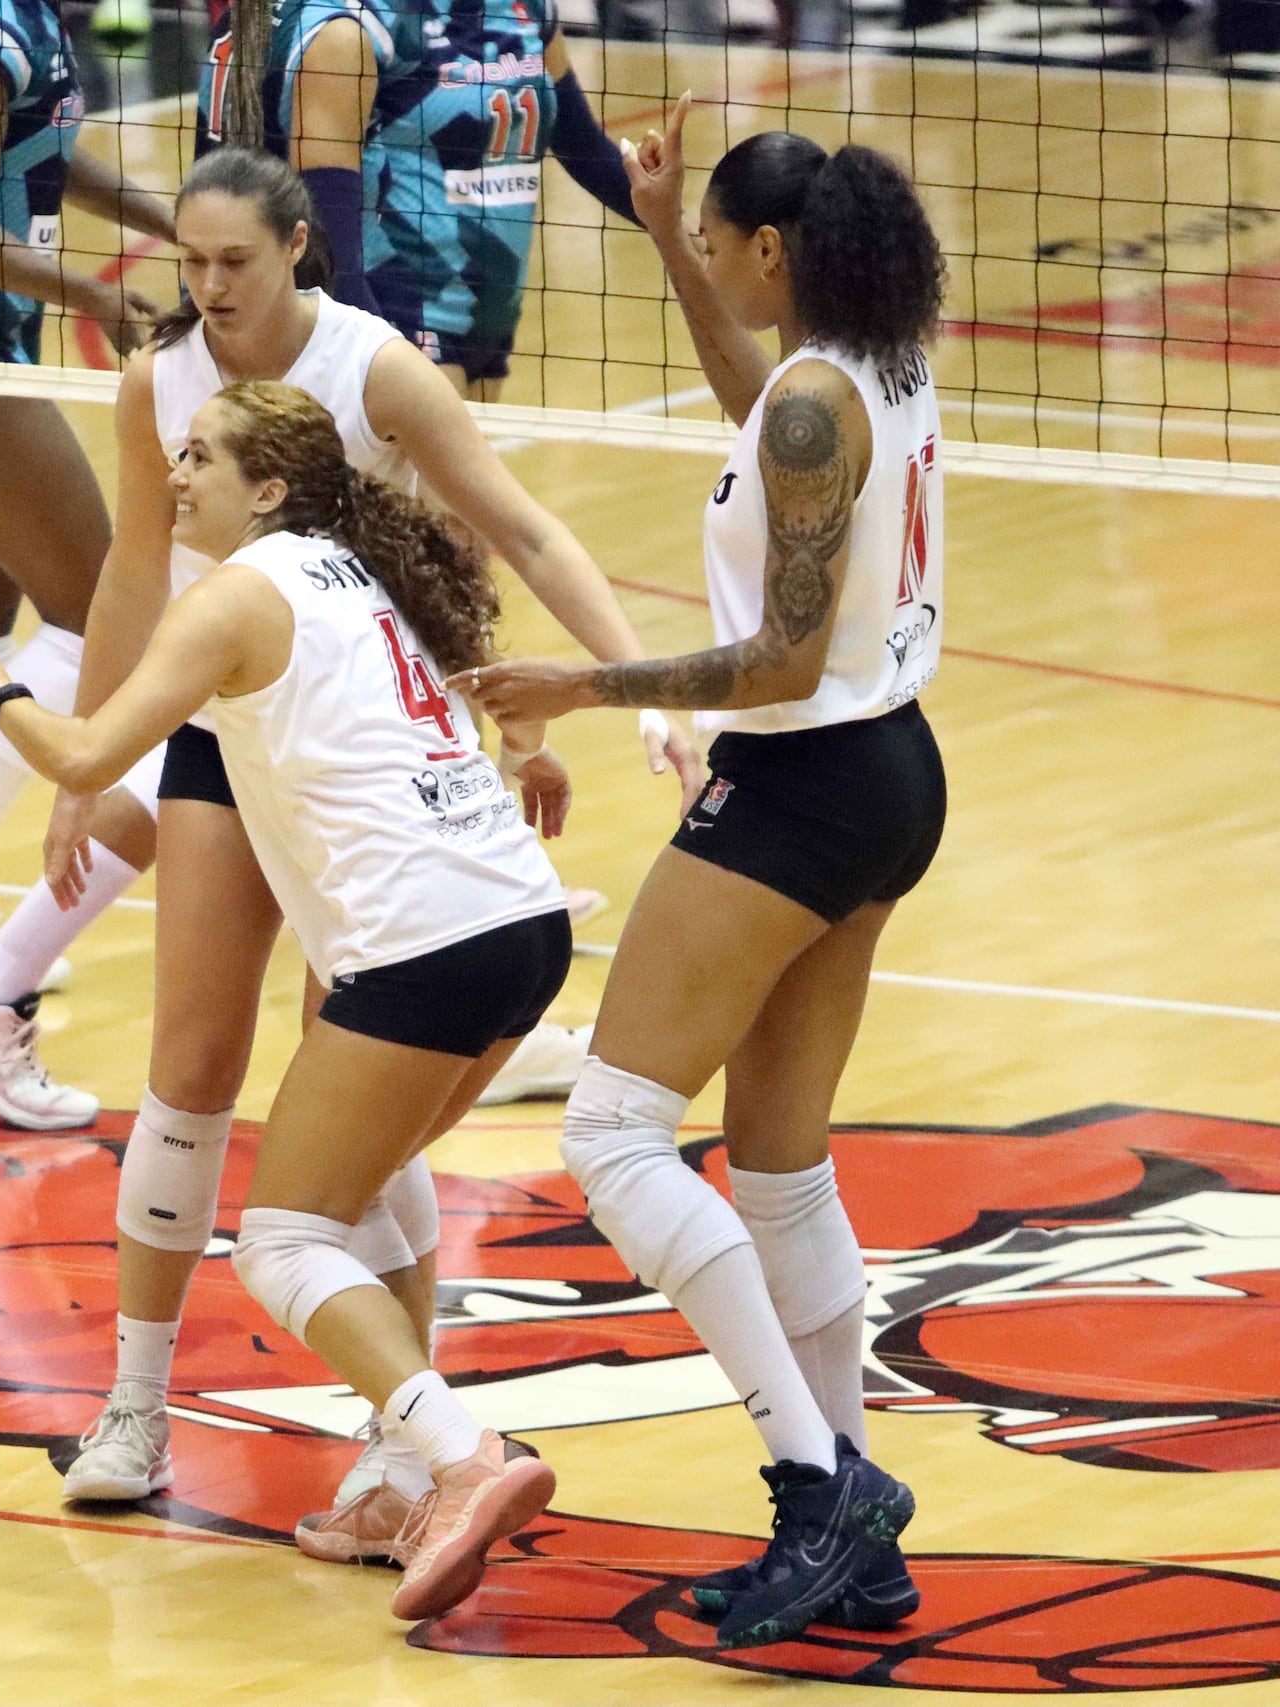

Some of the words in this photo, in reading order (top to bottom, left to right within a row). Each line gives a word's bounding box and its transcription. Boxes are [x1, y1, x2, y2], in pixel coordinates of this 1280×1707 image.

[487, 84, 540, 162] 11
[372, 608, 461, 745] 4
[436, 811, 488, 839] PONCE
